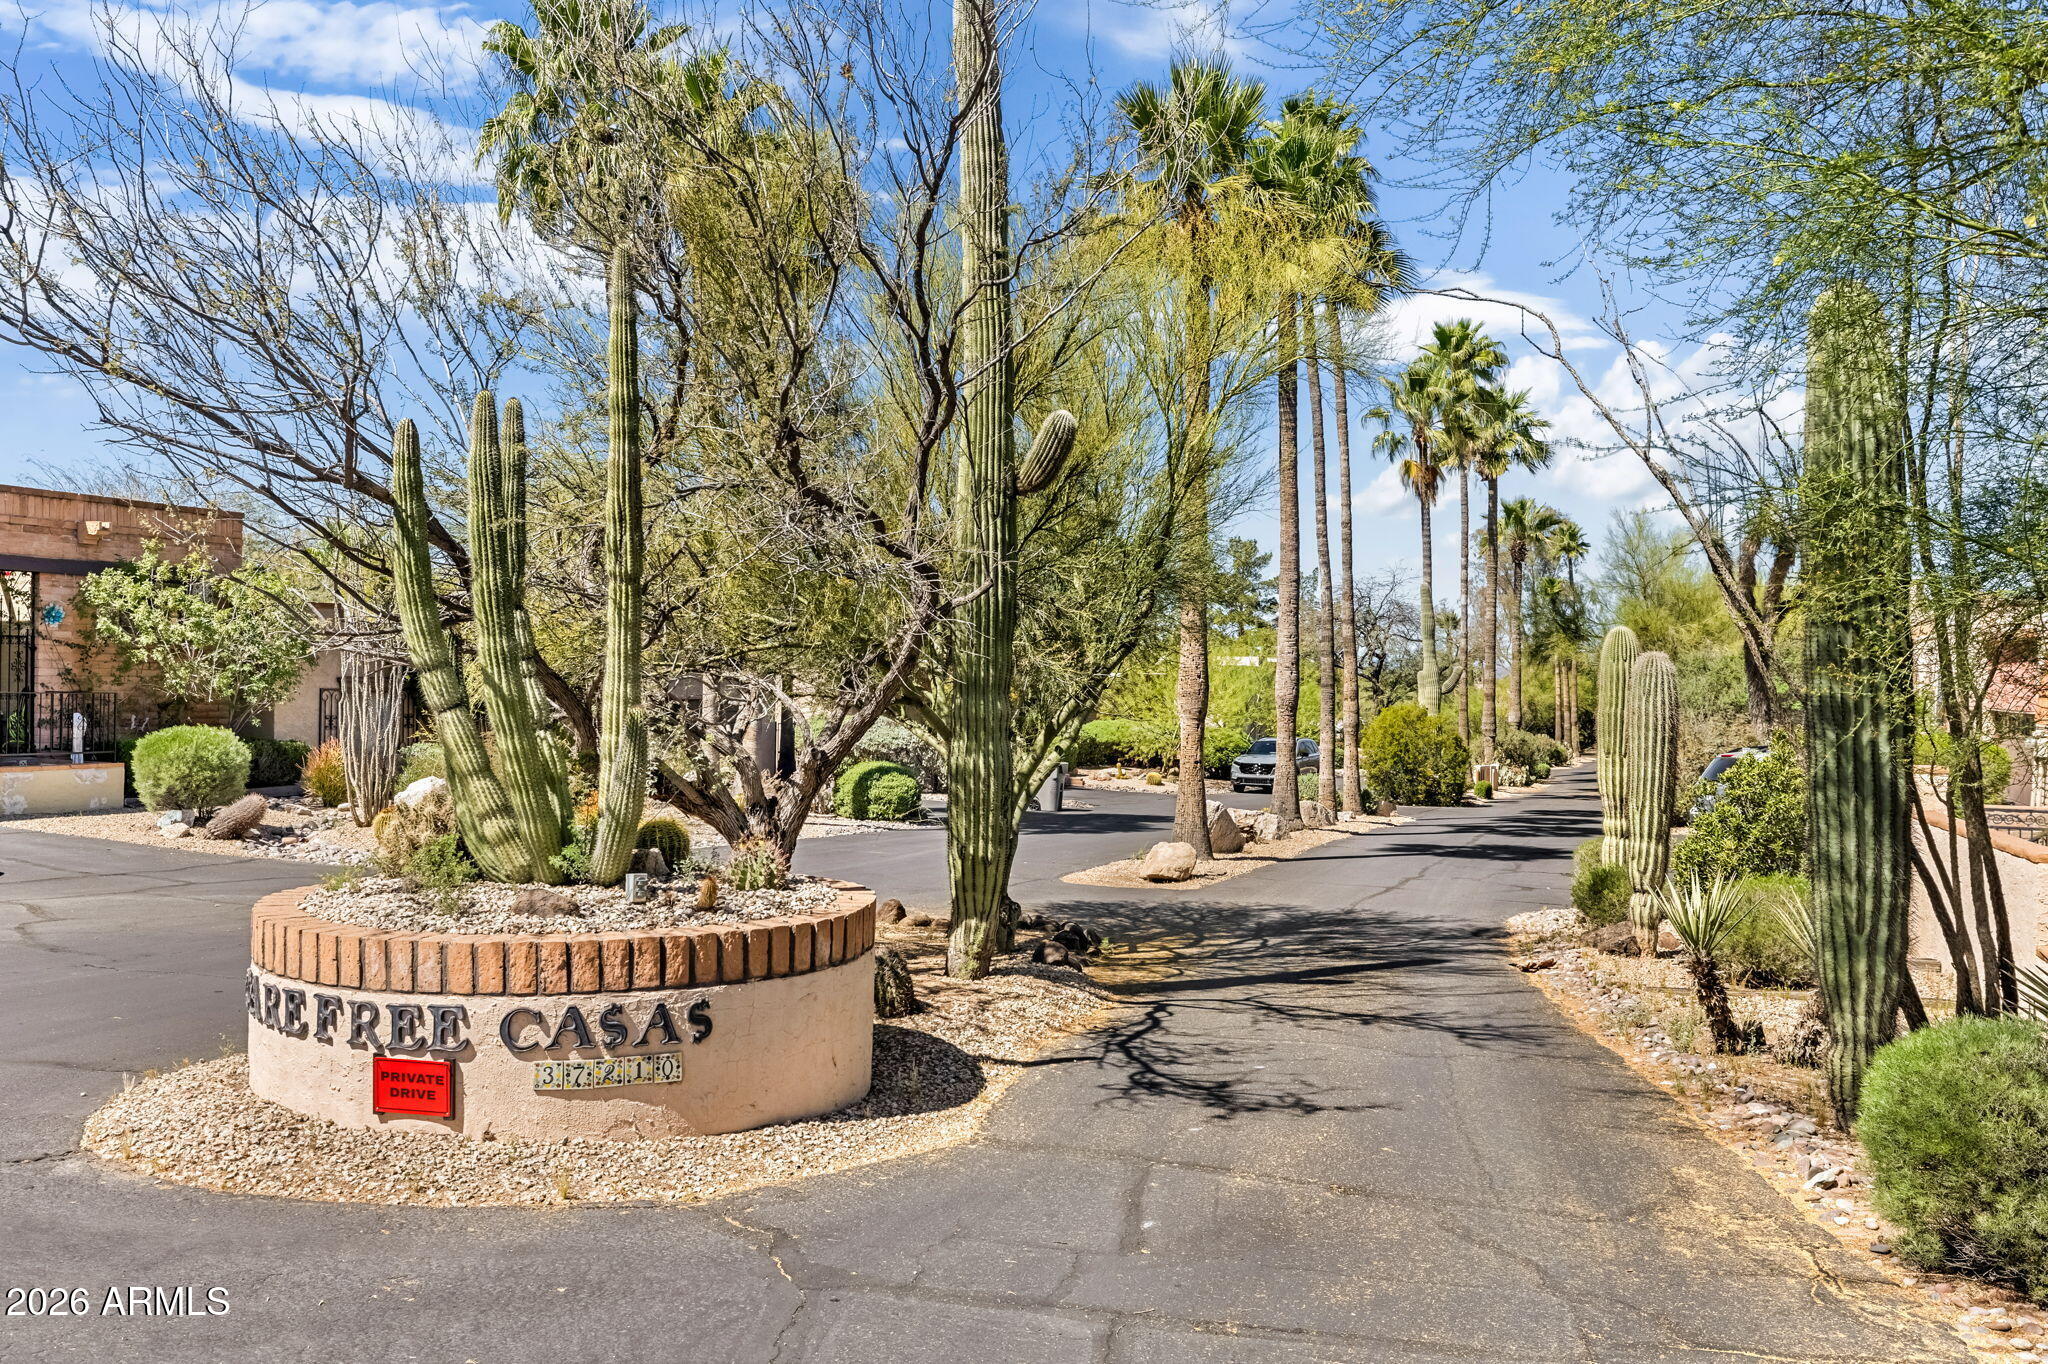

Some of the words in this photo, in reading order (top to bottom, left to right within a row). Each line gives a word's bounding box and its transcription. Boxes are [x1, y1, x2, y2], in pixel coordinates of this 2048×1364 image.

[245, 968, 469, 1052] AREFREE
[500, 999, 713, 1053] CASAS
[380, 1071, 445, 1086] PRIVATE
[543, 1059, 674, 1085] 37210
[389, 1087, 437, 1100] DRIVE
